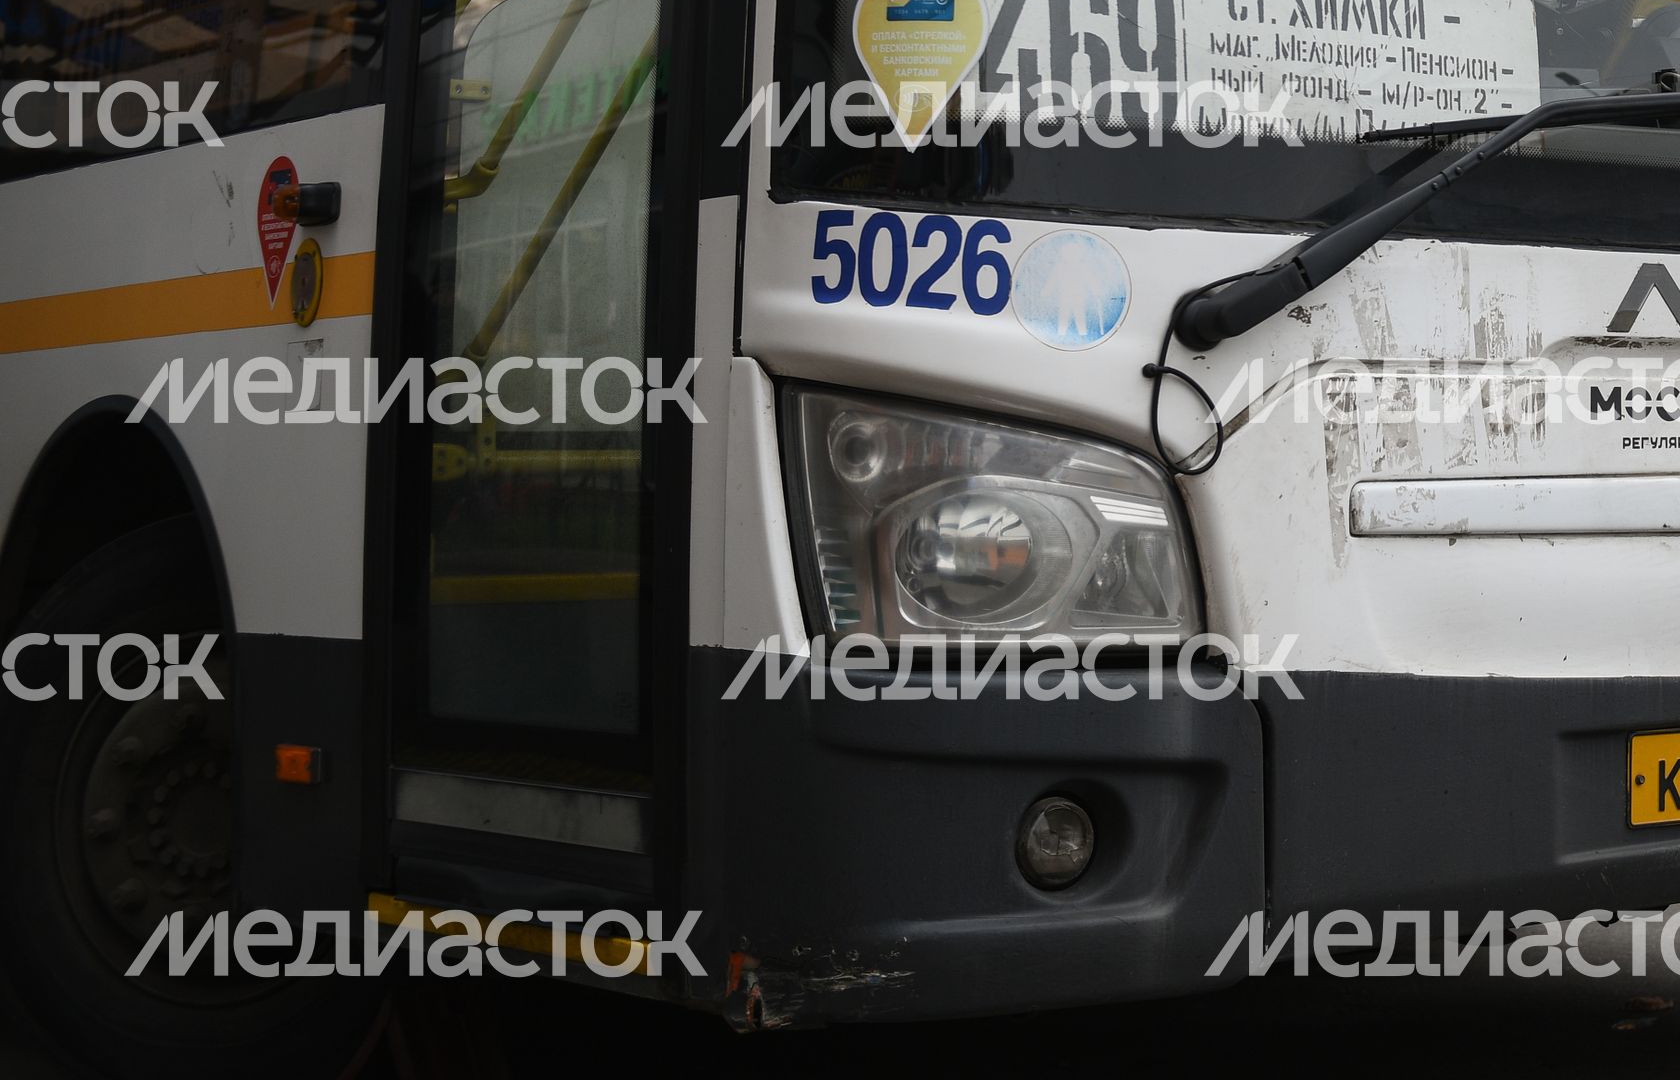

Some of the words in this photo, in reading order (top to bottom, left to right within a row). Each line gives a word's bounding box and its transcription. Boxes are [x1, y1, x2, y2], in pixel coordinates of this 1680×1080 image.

[872, 31, 907, 41] ОПЛАТА
[871, 44, 878, 53] И
[811, 209, 1012, 316] 5026
